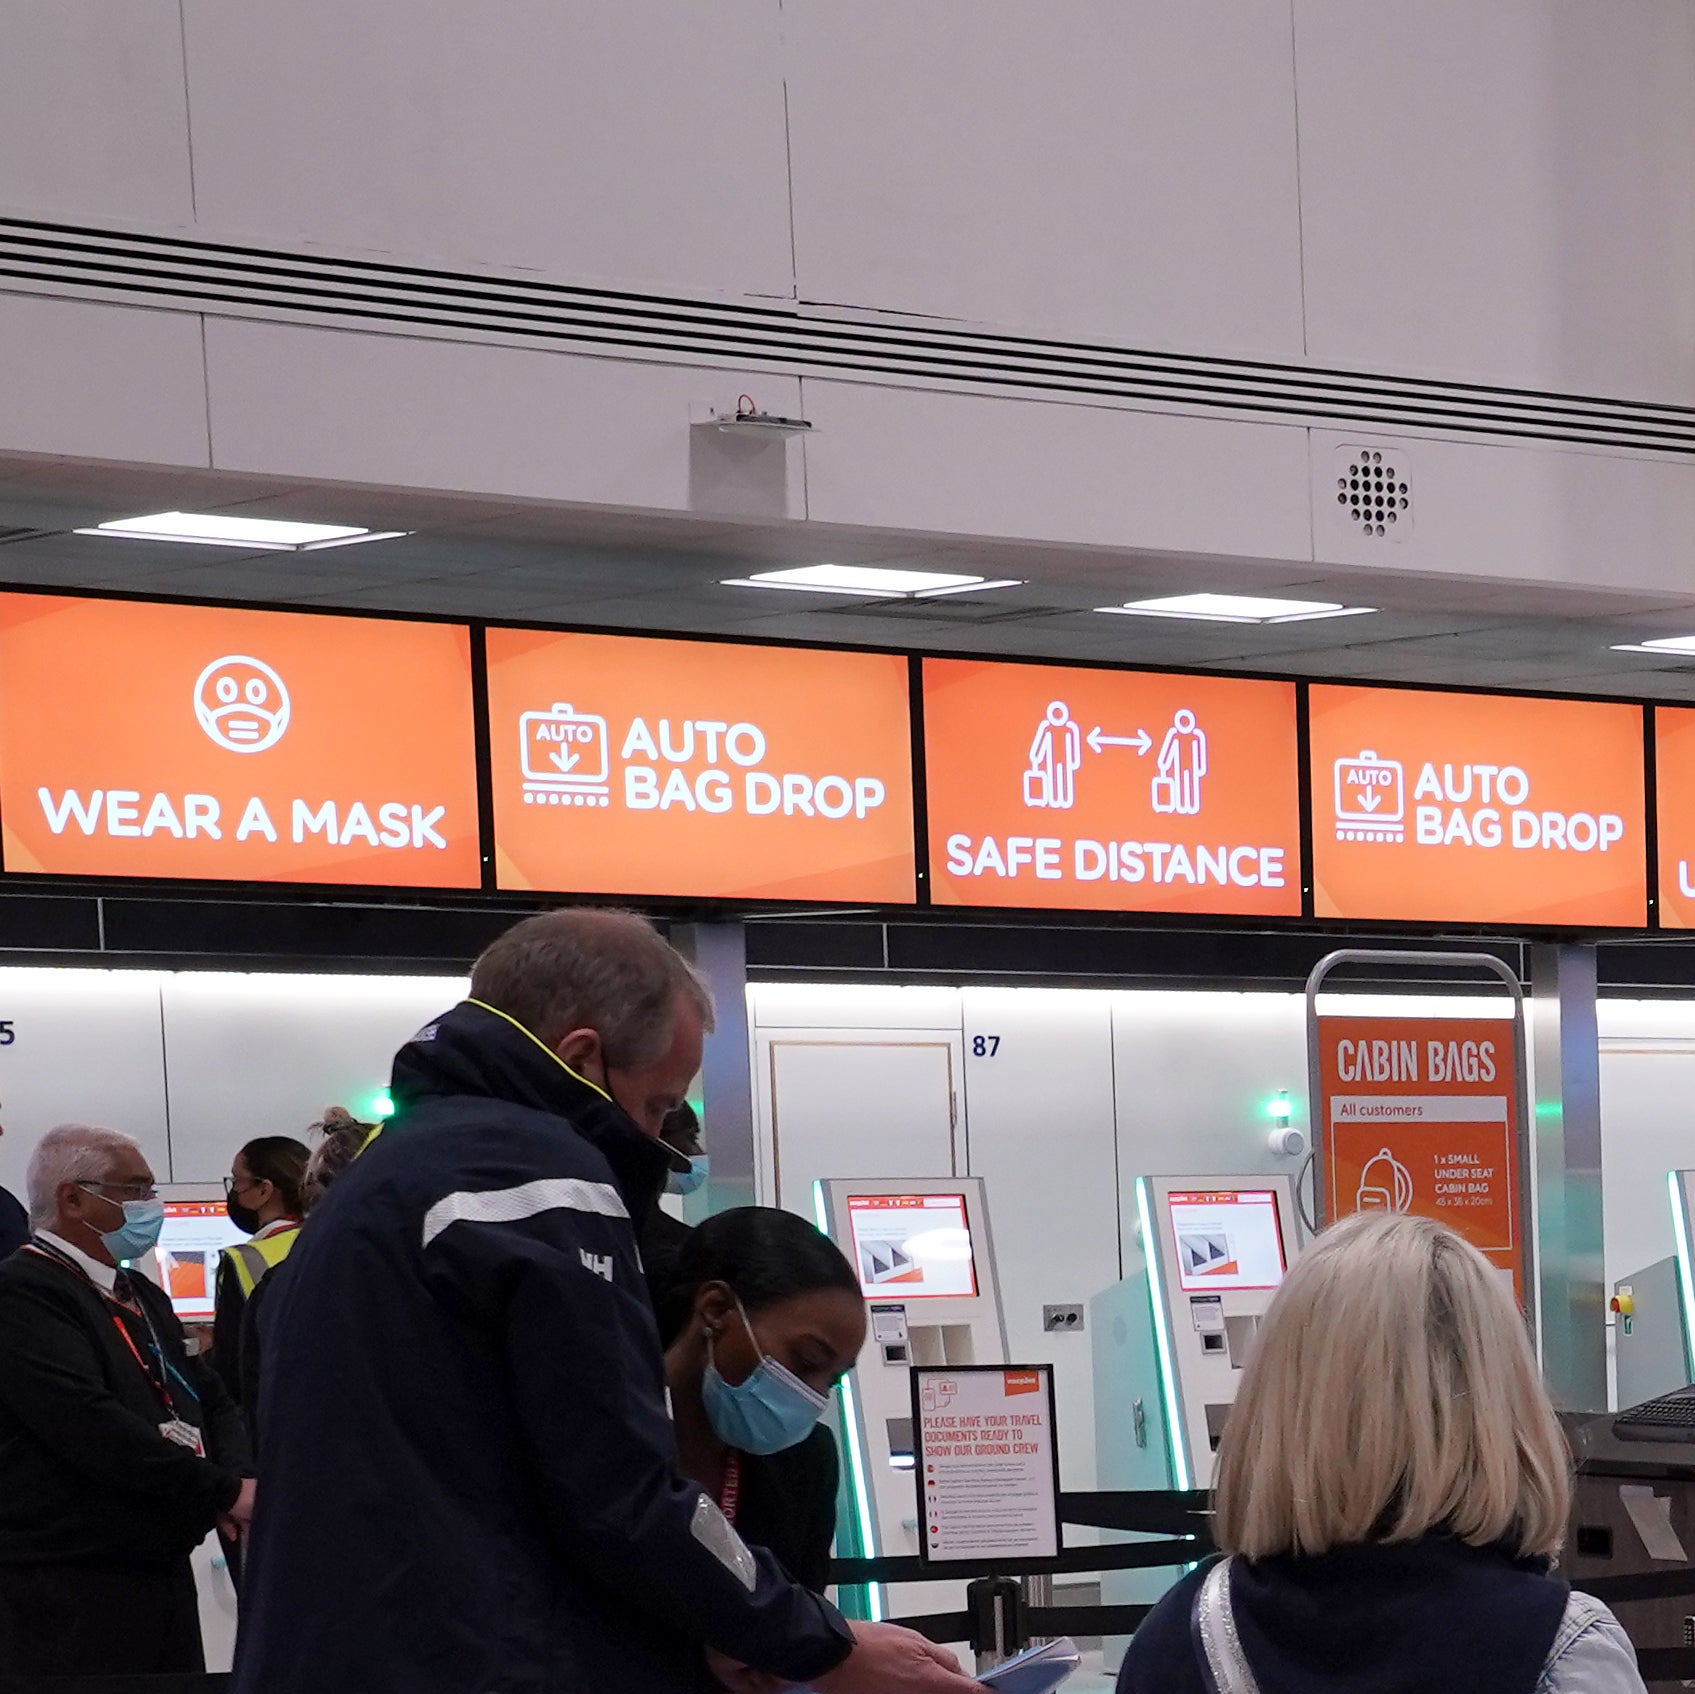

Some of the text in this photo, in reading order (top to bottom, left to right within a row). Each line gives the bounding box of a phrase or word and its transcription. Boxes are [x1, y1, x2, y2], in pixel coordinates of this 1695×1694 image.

[535, 723, 594, 744] AUTO
[620, 717, 767, 767] AUTO
[1346, 768, 1392, 786] AUTO
[1413, 762, 1530, 806] AUTO
[624, 765, 886, 819] BAG DROP
[37, 786, 447, 850] WEAR A MASK
[1415, 806, 1624, 852] BAG DROP
[946, 833, 1286, 888] SAFE DISTANCE
[972, 1038, 1001, 1065] 87
[1337, 1039, 1496, 1083] CABIN BAGS
[1340, 1103, 1423, 1117] All customers
[1433, 1154, 1480, 1165] 1 x SMALL
[1434, 1167, 1494, 1179] UNDER SEAT
[1435, 1183, 1489, 1194] CABIN BAG
[923, 1414, 1042, 1429] PLEASE HAVE YOUR TRAVEL
[924, 1429, 1023, 1443] DOCUMENTS READY TO
[925, 1442, 1039, 1457] SHOW OUR GROUND CREW
